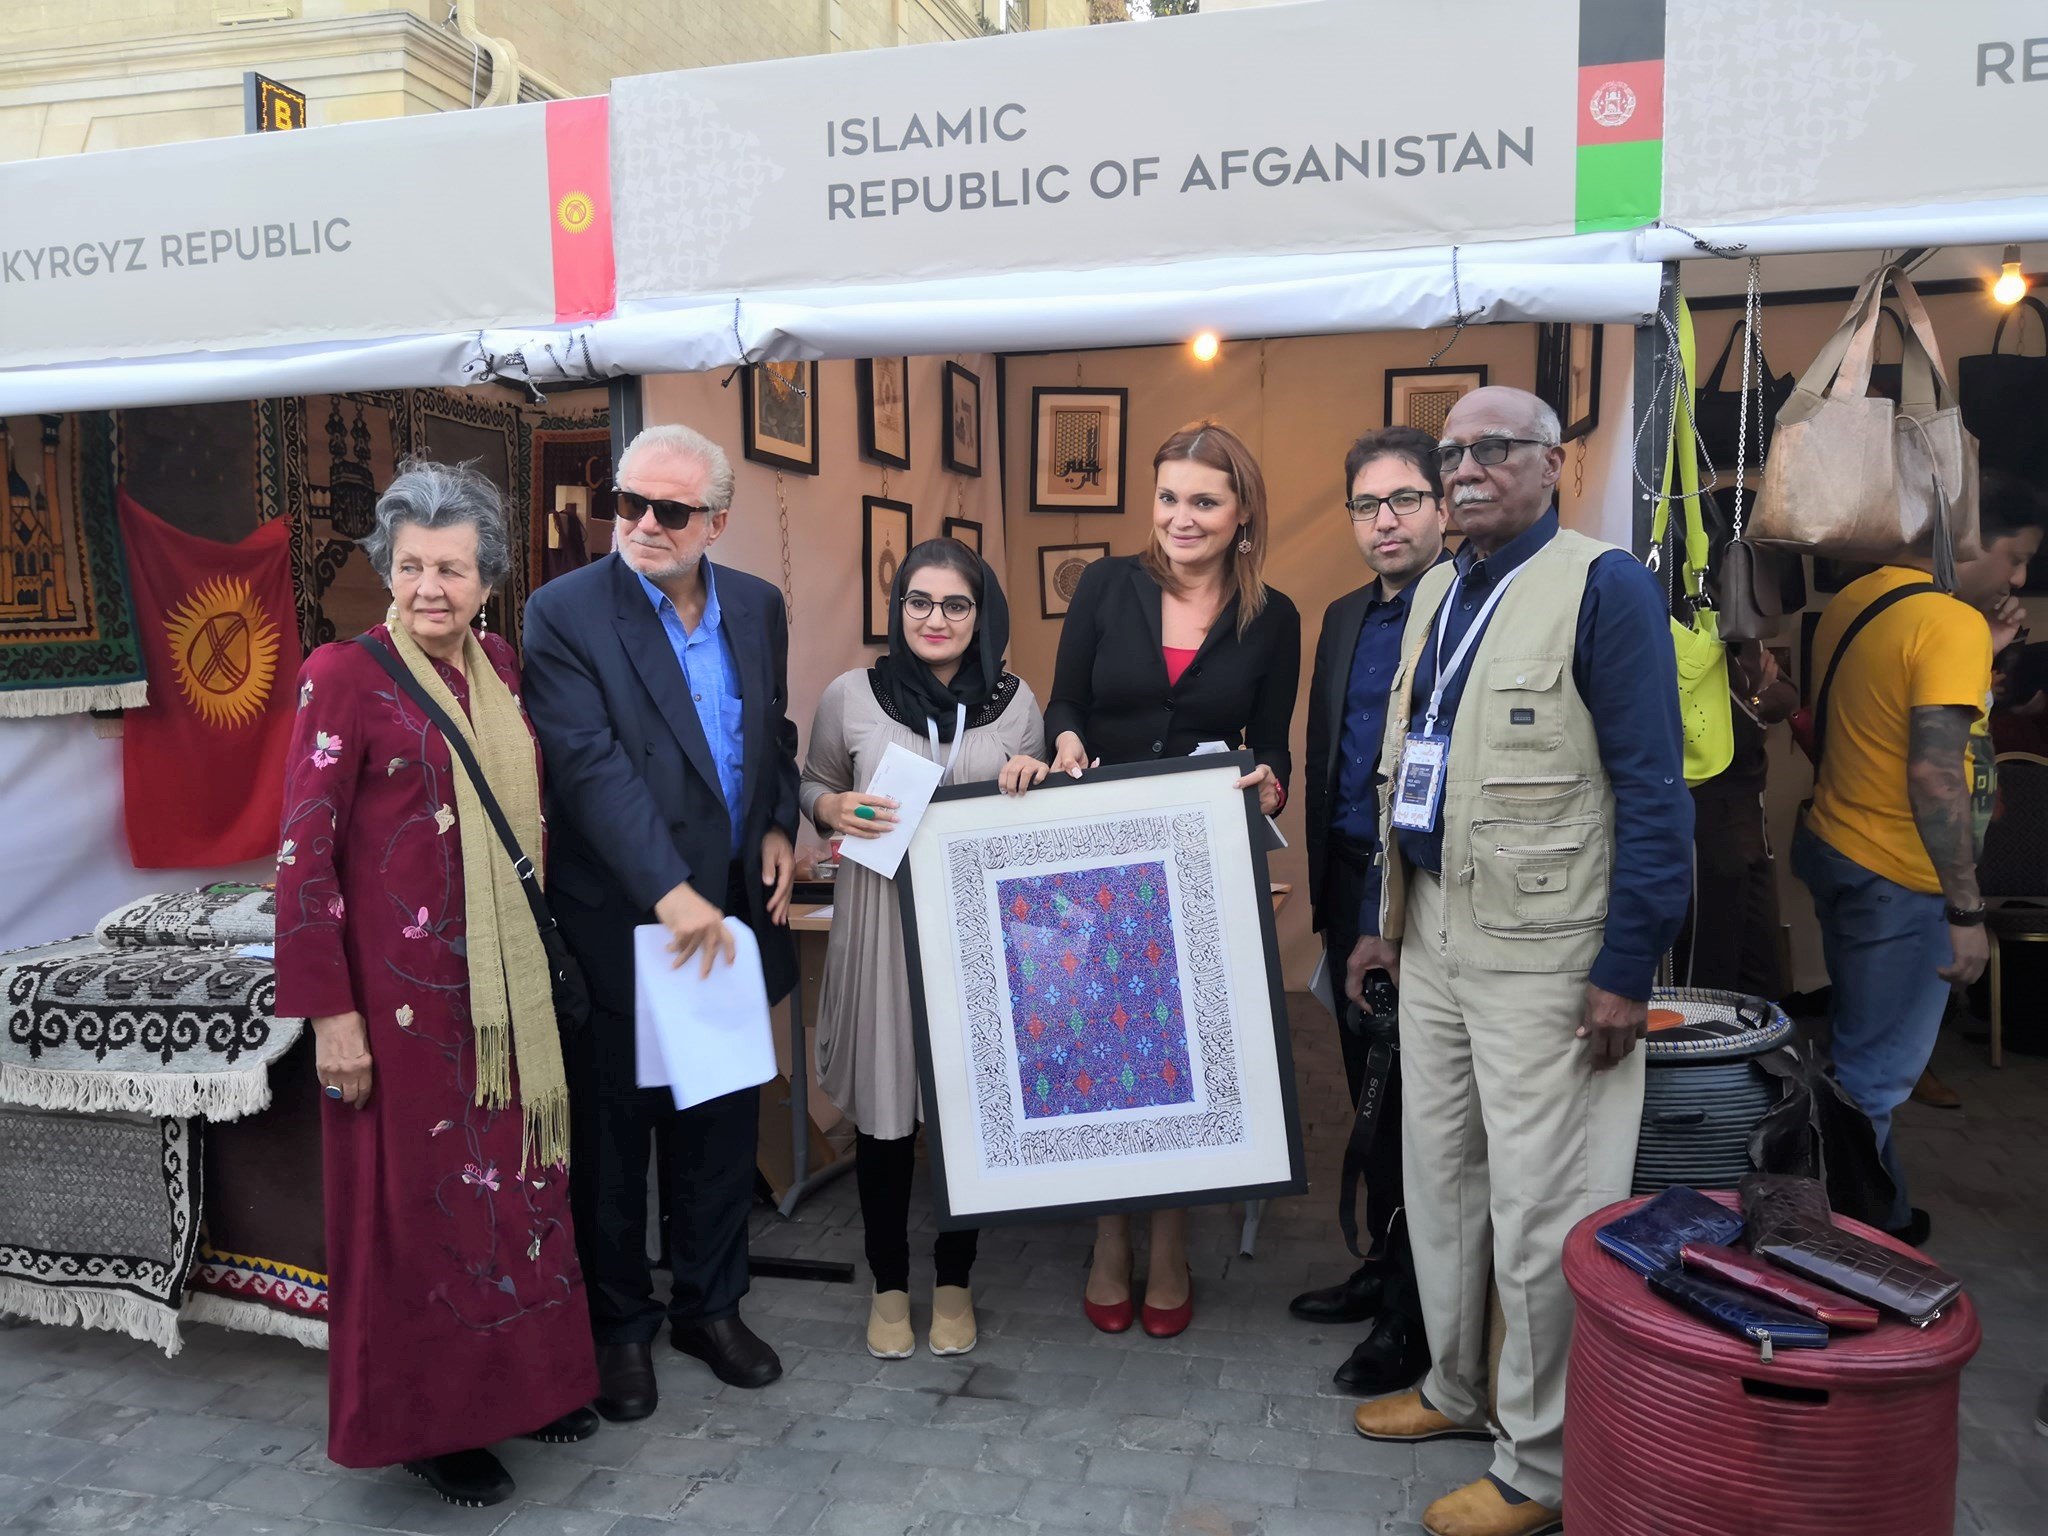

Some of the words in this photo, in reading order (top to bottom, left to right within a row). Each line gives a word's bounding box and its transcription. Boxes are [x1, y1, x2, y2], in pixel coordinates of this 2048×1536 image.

[1976, 37, 2048, 87] RE
[275, 98, 292, 130] B
[827, 103, 1027, 158] ISLAMIC
[827, 165, 1071, 221] REPUBLIC
[1089, 156, 1160, 200] OF
[1179, 126, 1535, 194] AFGANISTAN
[2, 234, 148, 283] KYRGYZ
[160, 217, 352, 268] REPUBLIC
